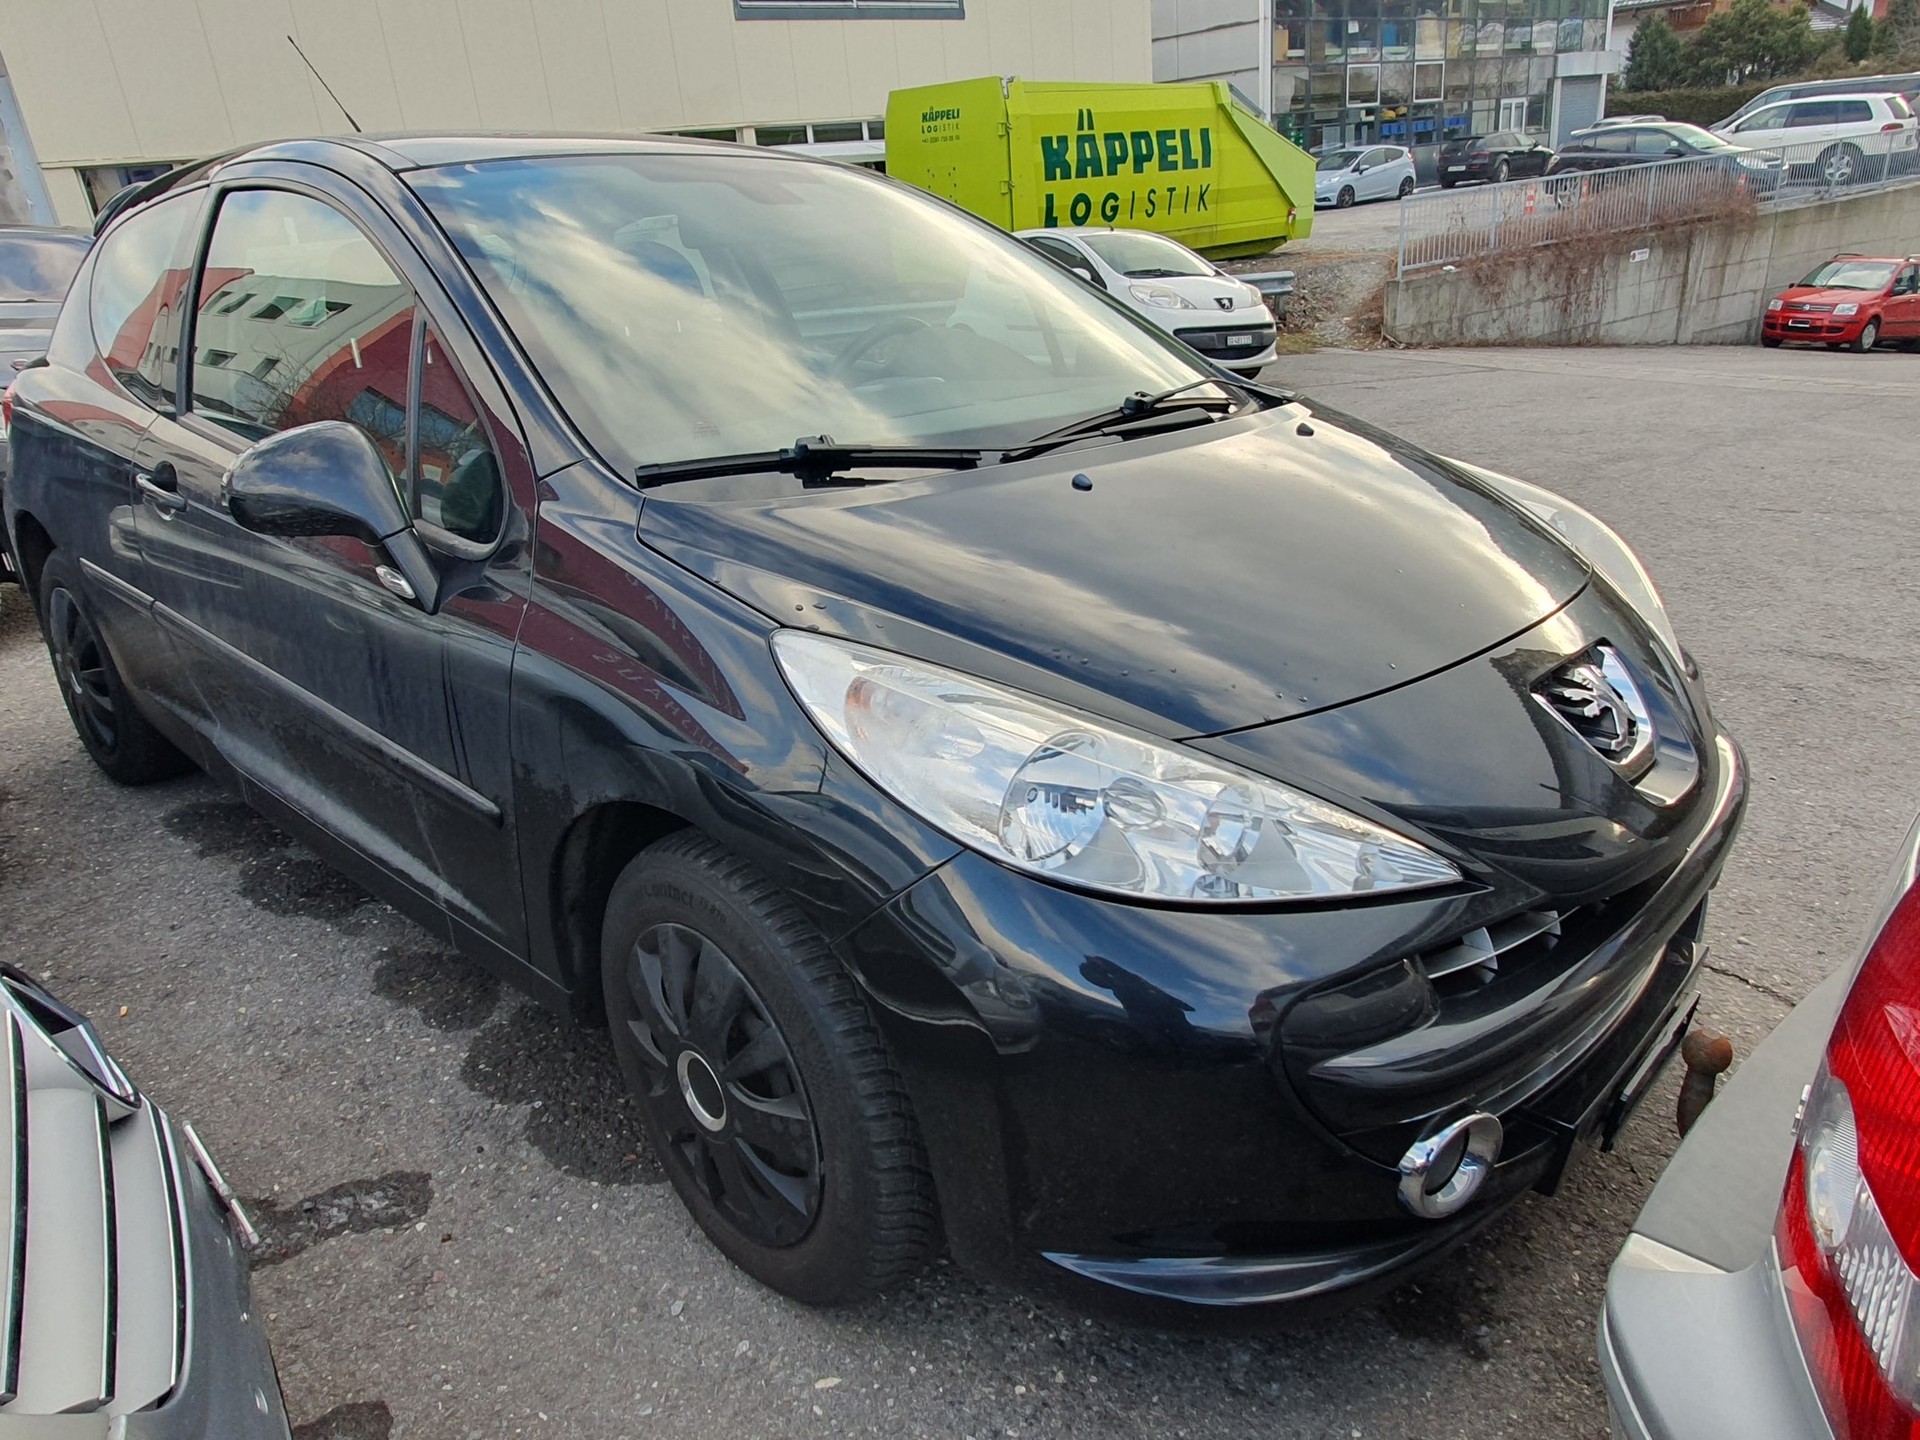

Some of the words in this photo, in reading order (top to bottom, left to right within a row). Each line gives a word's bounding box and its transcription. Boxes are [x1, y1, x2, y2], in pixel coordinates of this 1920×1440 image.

[921, 122, 960, 134] LOGISTIK
[922, 106, 960, 123] KÄPPELI
[1040, 108, 1212, 182] KÄPPELI
[1043, 183, 1211, 229] LOGISTIK
